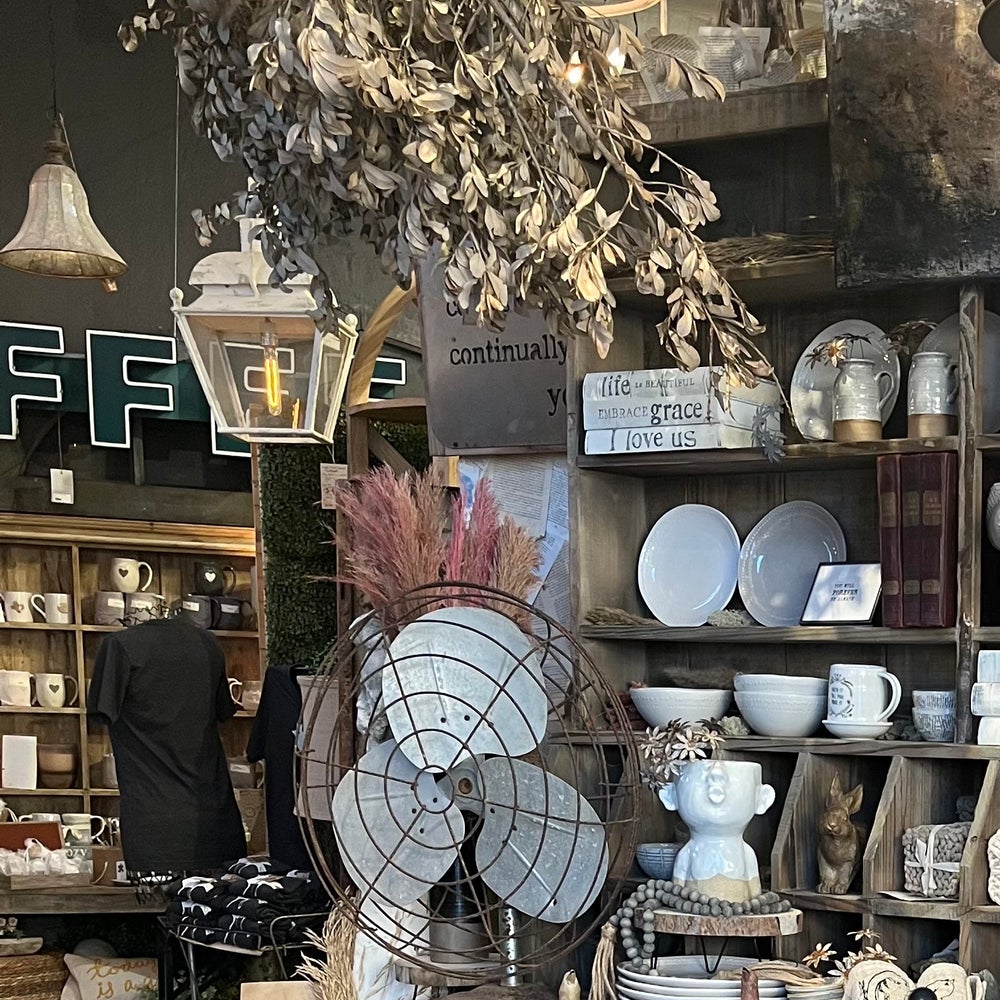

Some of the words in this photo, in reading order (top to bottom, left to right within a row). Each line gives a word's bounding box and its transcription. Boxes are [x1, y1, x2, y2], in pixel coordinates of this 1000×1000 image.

[450, 334, 567, 366] continually
[602, 375, 631, 397] life
[645, 378, 695, 389] BEAUTIFUL
[598, 406, 648, 419] EMBRACE
[650, 402, 702, 425] grace
[610, 429, 616, 451] I
[626, 430, 663, 450] love
[672, 430, 697, 447] us
